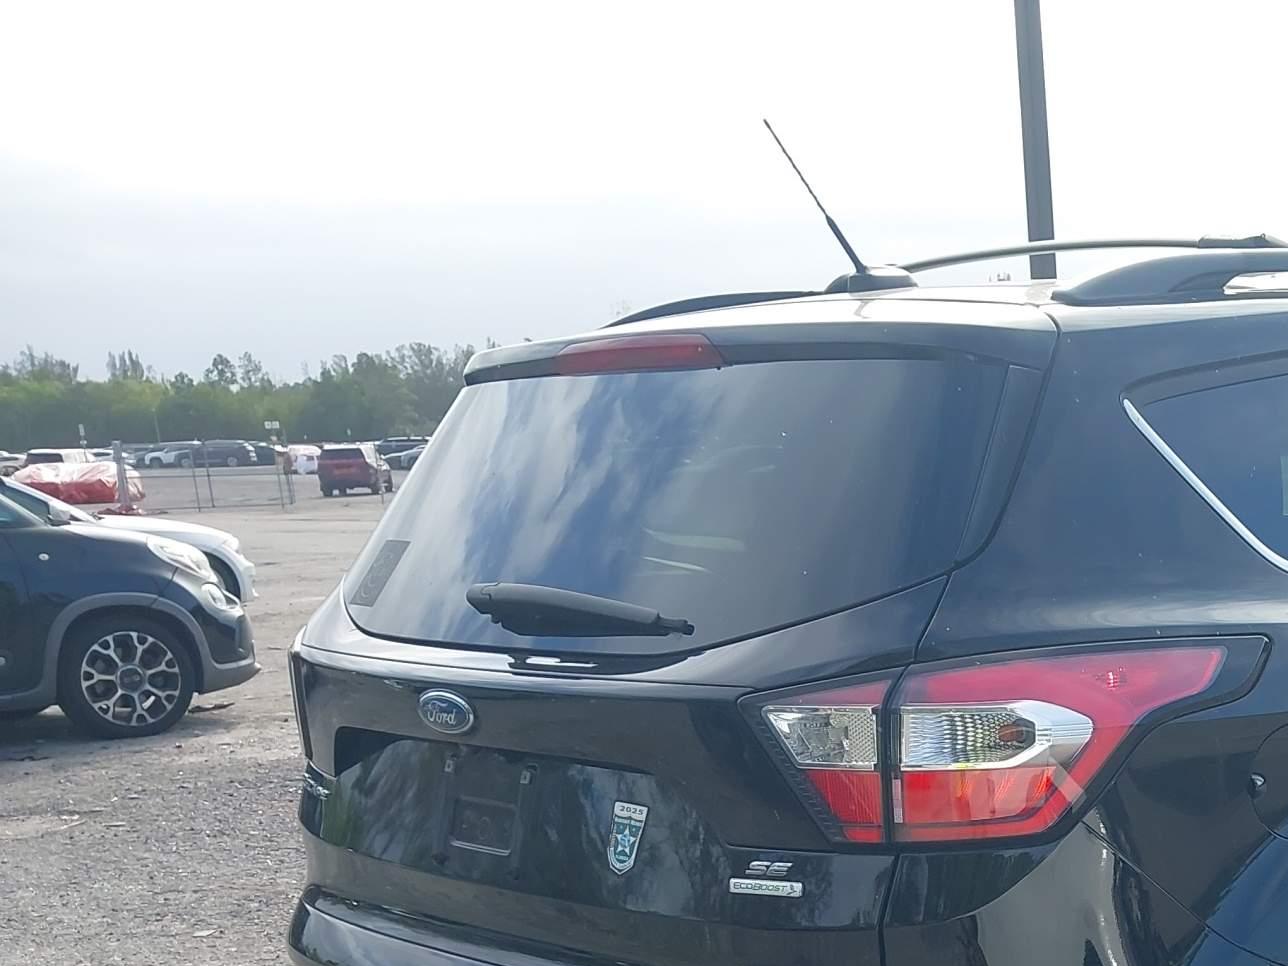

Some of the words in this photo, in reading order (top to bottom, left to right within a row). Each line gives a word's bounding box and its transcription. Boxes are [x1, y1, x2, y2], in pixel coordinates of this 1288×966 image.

[423, 700, 457, 725] Ford
[619, 805, 644, 815] 2025
[745, 861, 793, 877] SE
